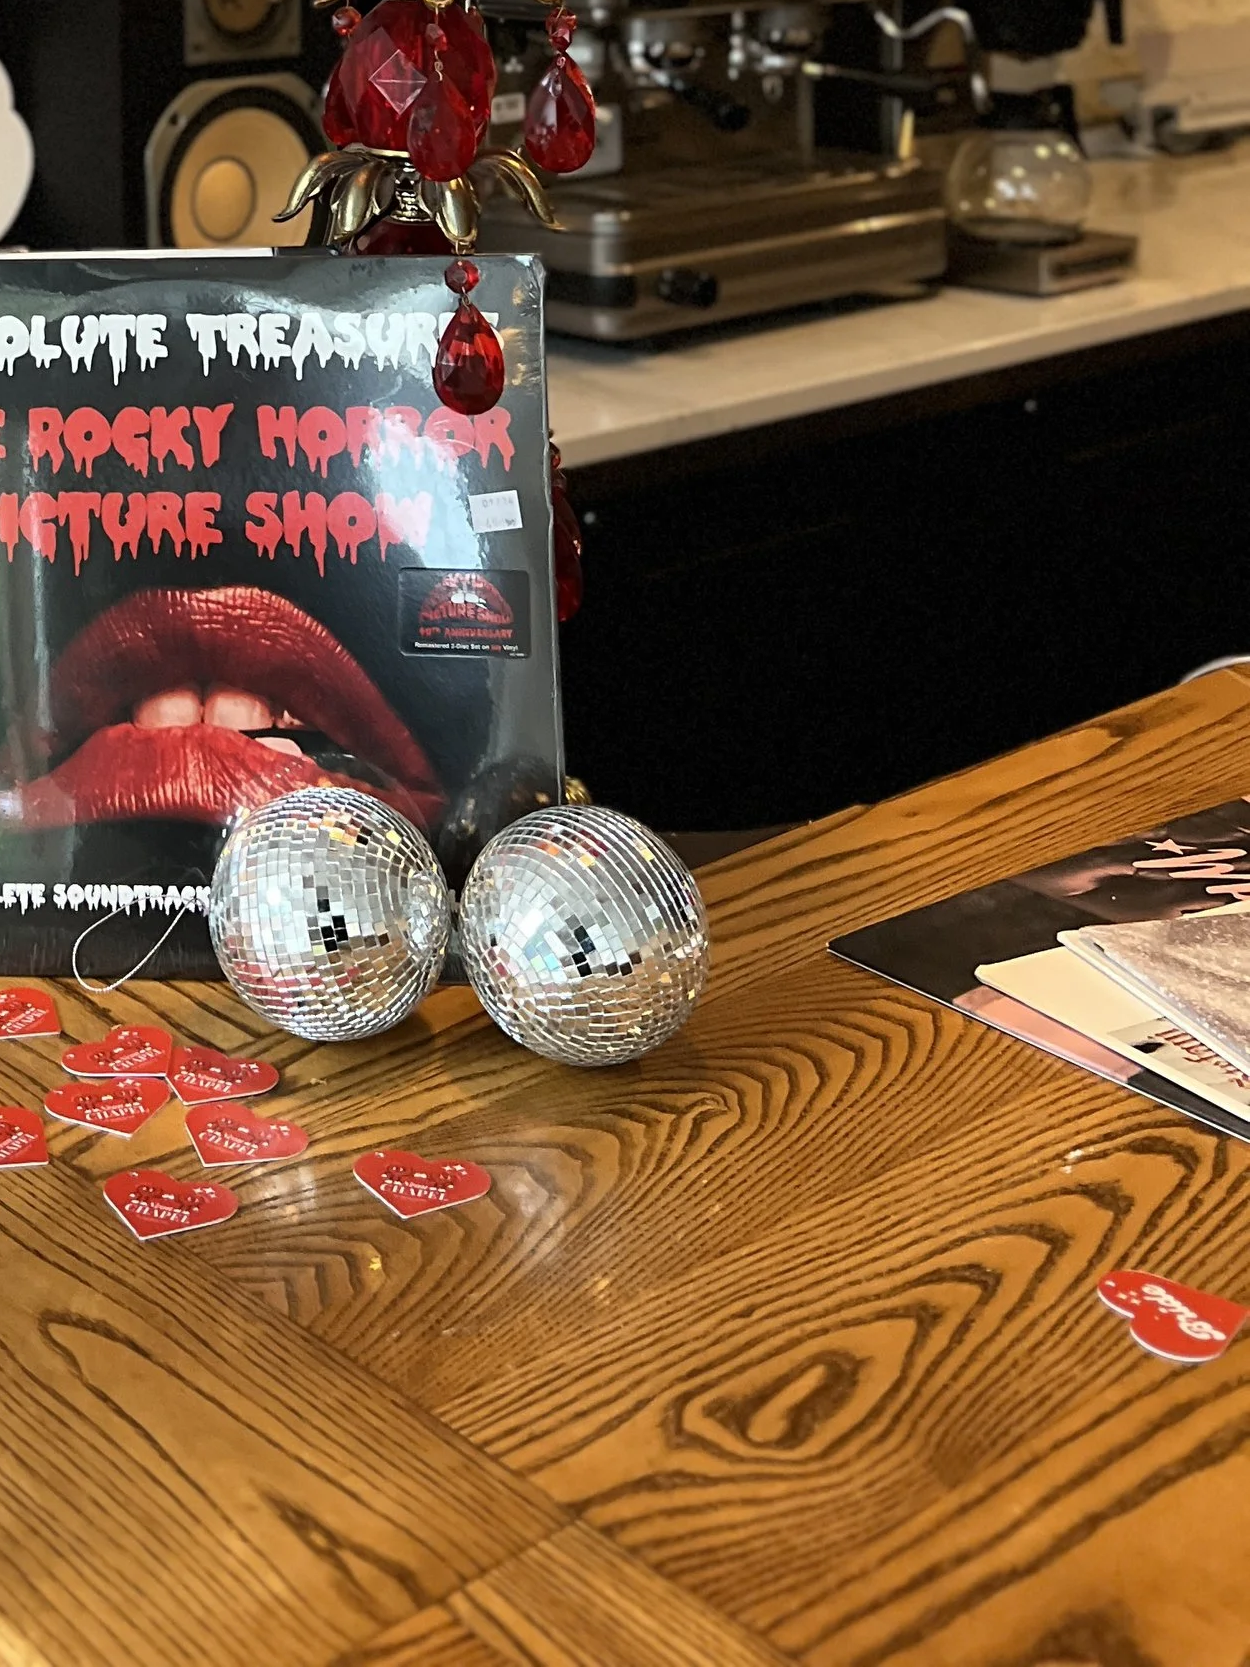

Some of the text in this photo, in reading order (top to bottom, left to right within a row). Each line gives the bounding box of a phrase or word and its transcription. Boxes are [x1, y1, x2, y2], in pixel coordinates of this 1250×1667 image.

[186, 311, 506, 380] TREASUR
[27, 403, 235, 479] ROCKY
[256, 404, 515, 479] HORROR
[244, 491, 434, 578] SHOW
[53, 883, 211, 917] SOUNDTRACK
[1141, 1282, 1227, 1341] Bride
